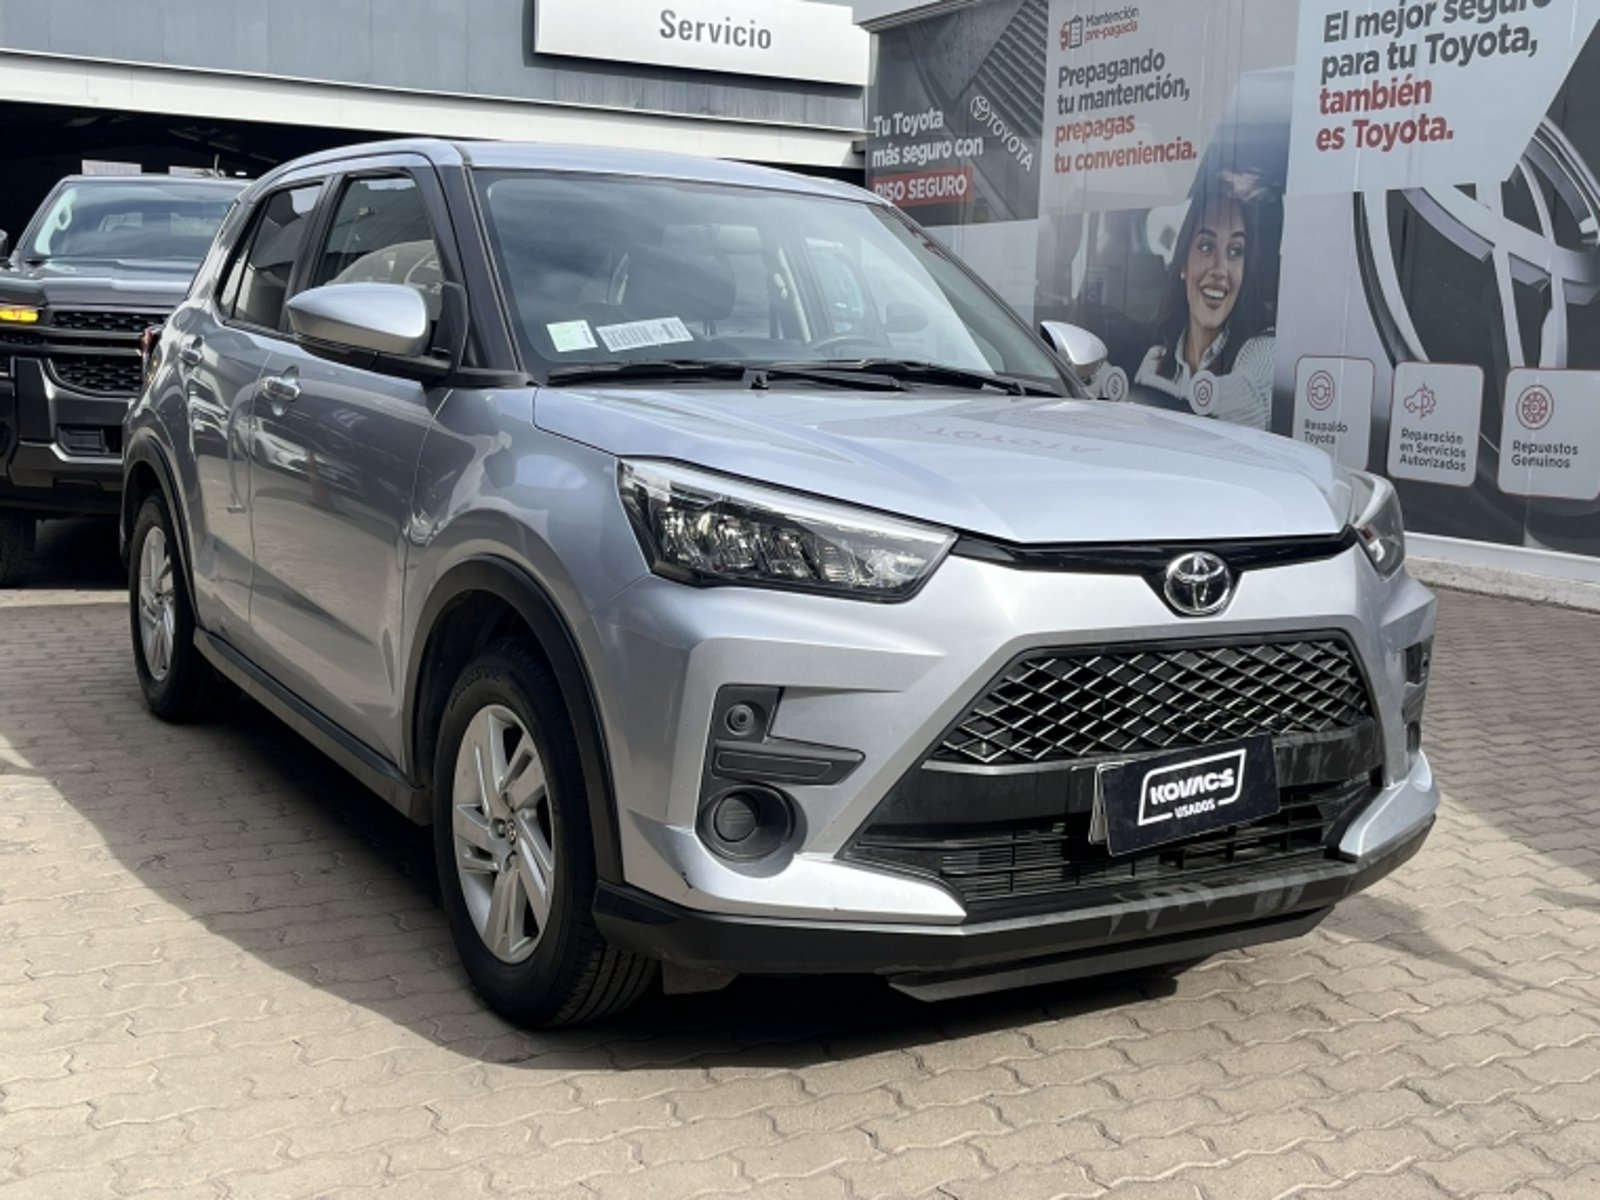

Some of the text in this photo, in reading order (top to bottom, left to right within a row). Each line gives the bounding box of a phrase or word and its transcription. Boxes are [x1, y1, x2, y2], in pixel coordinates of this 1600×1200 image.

[659, 9, 772, 50] Servicio
[1324, 10, 1348, 43] El
[1355, 2, 1436, 39] mejor
[1057, 48, 1166, 88] Prepagando
[1321, 24, 1538, 85] para tu Toyota,
[1057, 73, 1190, 115] tu mantención,
[1319, 73, 1432, 115] también
[873, 108, 944, 138] Tu Toyota
[1054, 112, 1136, 147] prepagas
[1316, 114, 1454, 152] es Toyota.
[872, 136, 984, 168] más seguro con
[985, 111, 1035, 173] TOYOTA
[1054, 136, 1197, 174] tu conveniencia.
[907, 174, 968, 200] SEGURO
[1304, 419, 1348, 433] Respaldo
[1304, 431, 1336, 445] Toyota
[1402, 428, 1464, 445] Reparación
[1400, 441, 1466, 459] en Servicios
[1400, 453, 1466, 472] Autorizados
[1511, 454, 1571, 468] Genuinos
[1513, 440, 1578, 455] Repuestos
[1150, 768, 1234, 806] KOVACS
[1174, 798, 1216, 819] USADOS
